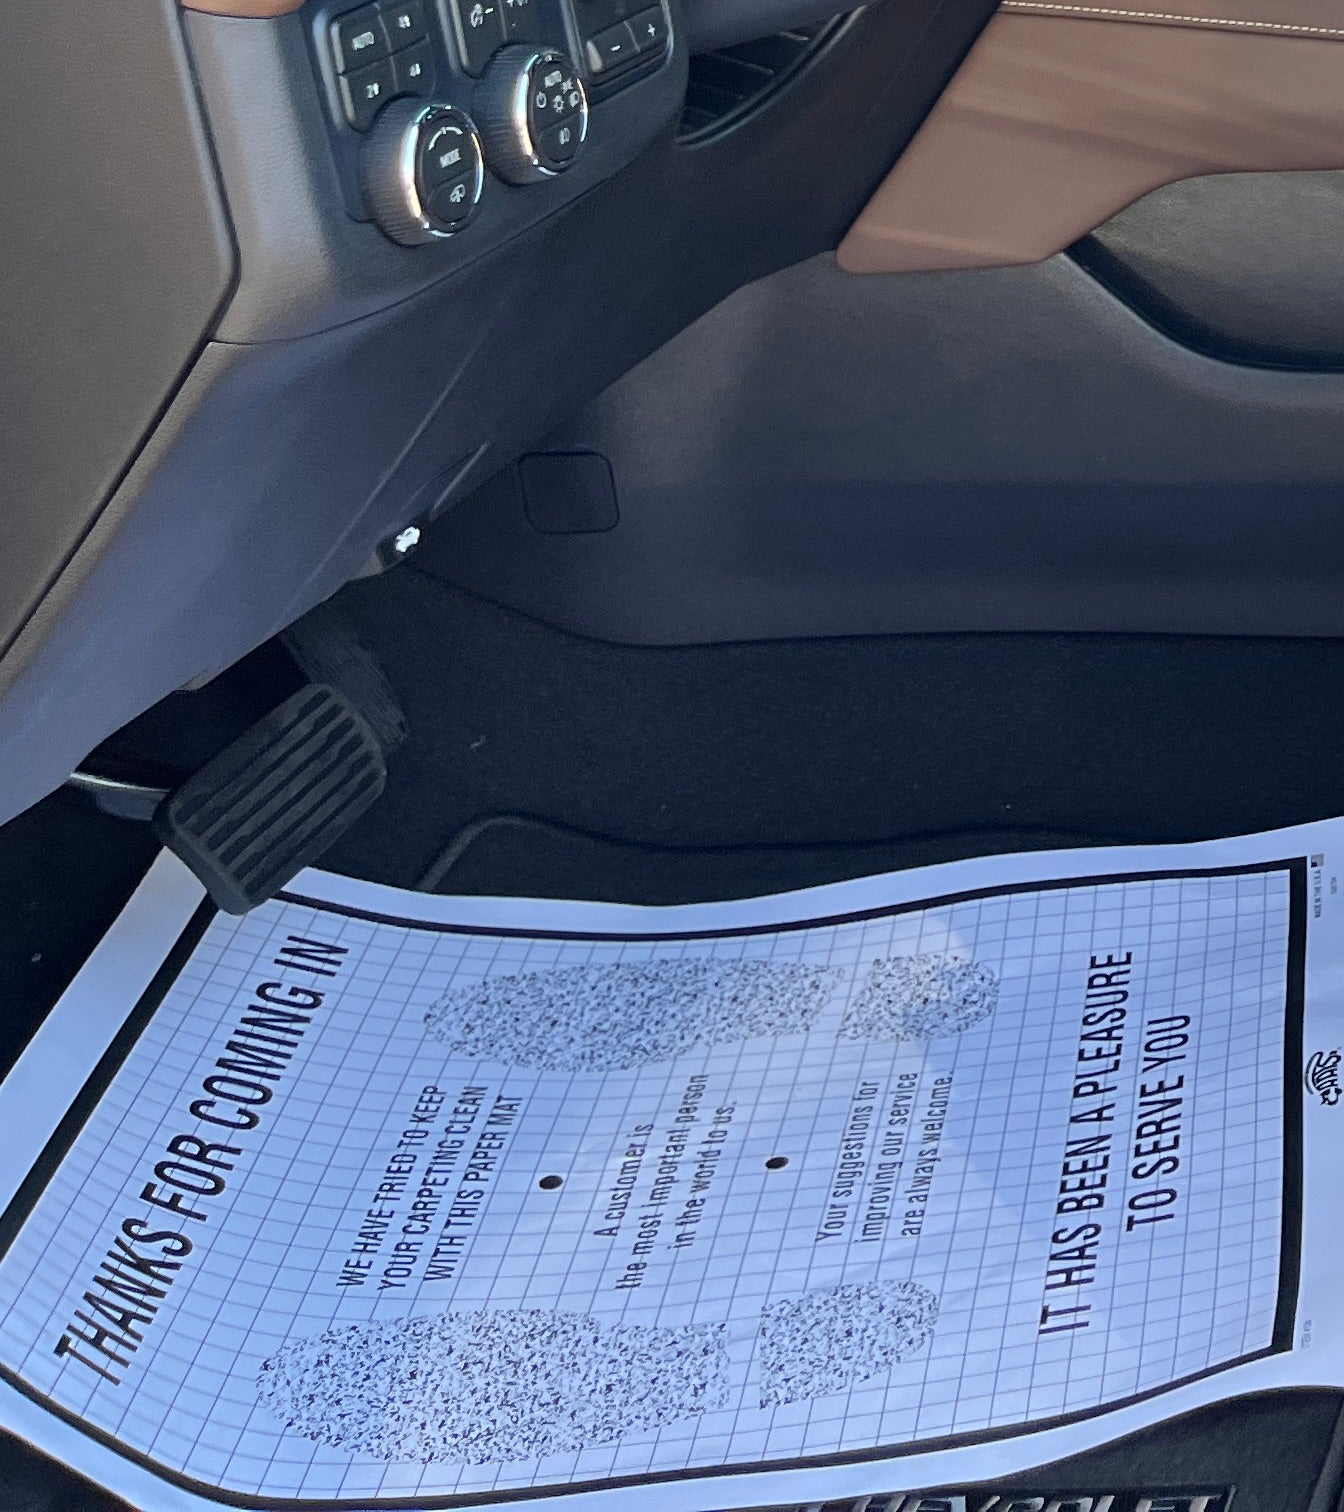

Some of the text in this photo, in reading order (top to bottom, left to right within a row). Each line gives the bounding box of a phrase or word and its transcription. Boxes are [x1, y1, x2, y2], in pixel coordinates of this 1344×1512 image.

[54, 935, 349, 1386] THANKS FOR COMING IN
[336, 1085, 448, 1287] WE HAVE TRIED TO KEEP
[377, 1086, 488, 1290] YOUR CARPETING CLEAN
[423, 1095, 522, 1281] WITH THIS PAPER MAT
[593, 1123, 654, 1237] A customer is
[615, 1074, 709, 1290] the most important person
[667, 1101, 737, 1249] in the world to us.
[815, 1081, 880, 1243] Your suggestions for
[853, 1072, 918, 1243] improving our service
[901, 1070, 954, 1236] are always welcome.
[1039, 951, 1132, 1335] IT HAS BEEN A PLEASURE
[1126, 1015, 1190, 1232] TO SERVE YOU
